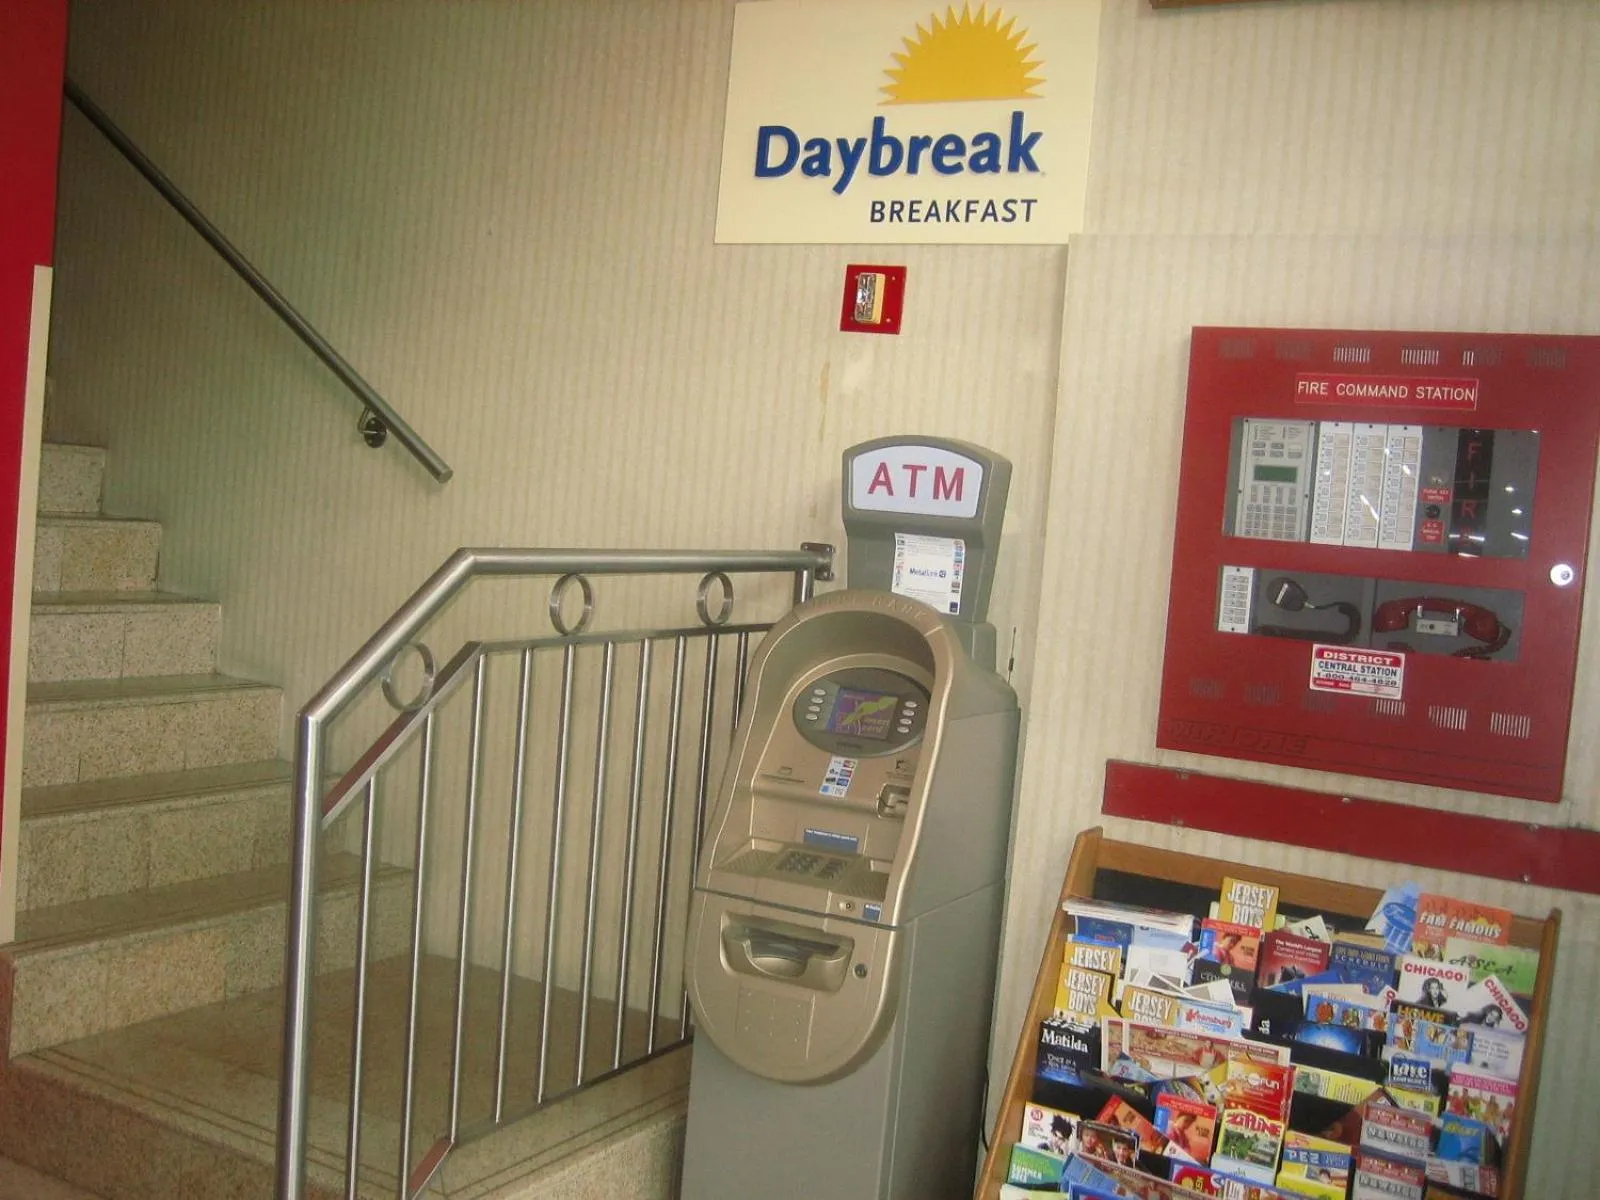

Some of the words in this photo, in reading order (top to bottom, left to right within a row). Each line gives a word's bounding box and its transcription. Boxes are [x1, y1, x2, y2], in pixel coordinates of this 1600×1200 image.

[754, 111, 1043, 195] Daybreak
[869, 199, 1038, 224] BREAKFAST
[1297, 381, 1328, 396] FIRE
[1336, 383, 1408, 399] COMMAND
[1415, 386, 1475, 402] STATION
[867, 461, 965, 502] ATM
[1318, 660, 1358, 673] CENTRAL
[1360, 665, 1397, 677] STATION
[1323, 651, 1393, 665] DISTRICT
[1227, 882, 1275, 910] JERSEY
[1231, 902, 1265, 929] BOYS
[1070, 946, 1116, 971] JERSEY
[1064, 967, 1106, 997] JERSEY
[1403, 962, 1462, 983] CHICAGO
[1068, 988, 1097, 1016] BOYS
[1127, 991, 1172, 1021] JERSEY
[1484, 978, 1526, 1031] CHICAGO
[1041, 1027, 1088, 1053] Matilda
[1285, 1149, 1320, 1165] PEZ
